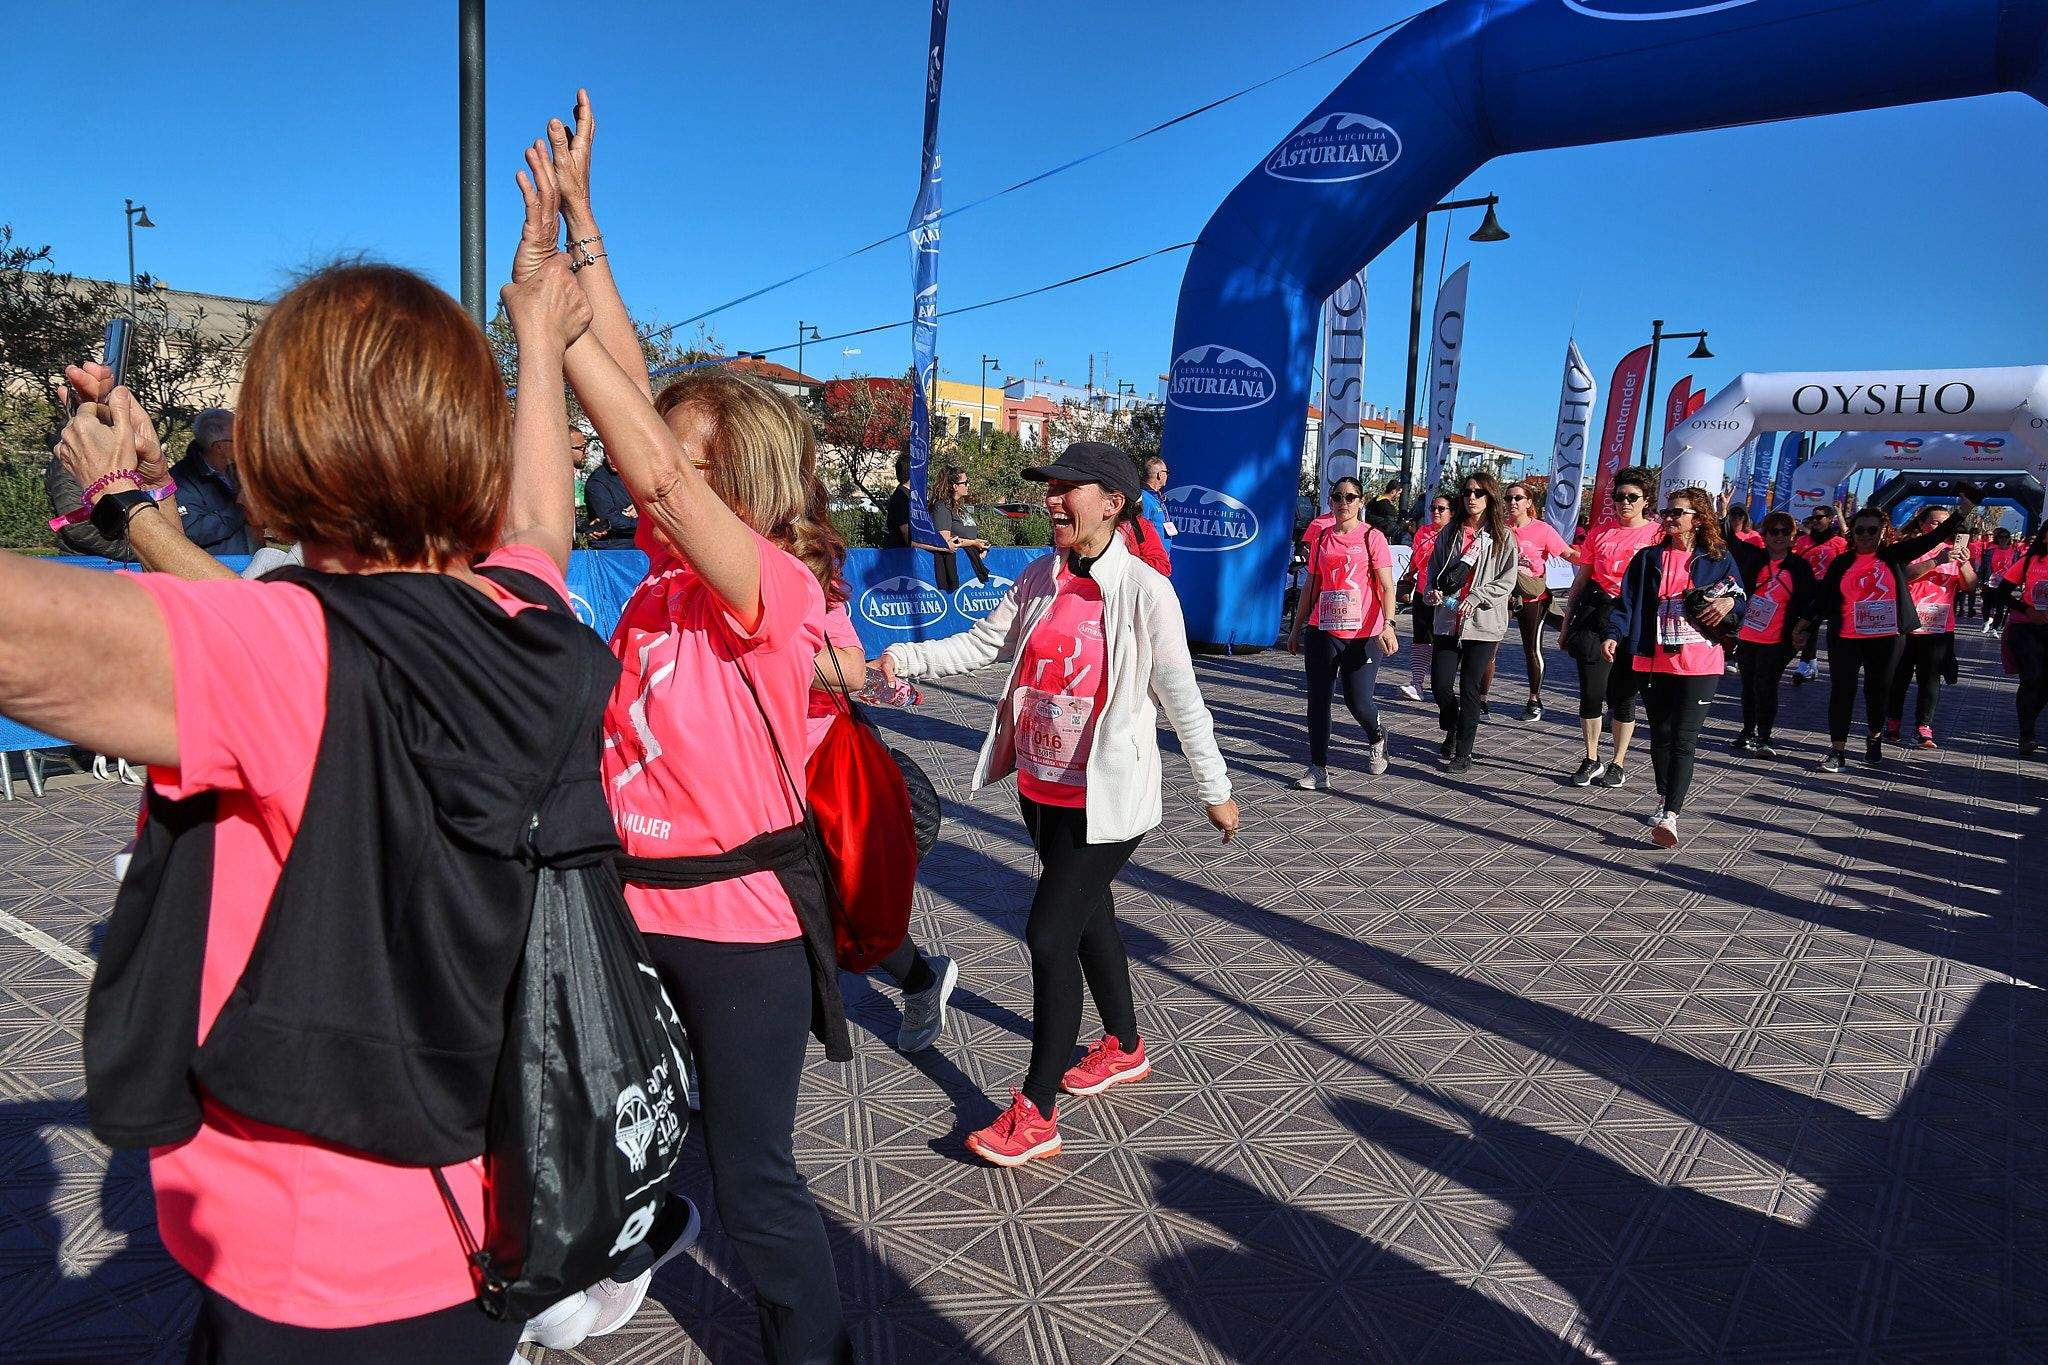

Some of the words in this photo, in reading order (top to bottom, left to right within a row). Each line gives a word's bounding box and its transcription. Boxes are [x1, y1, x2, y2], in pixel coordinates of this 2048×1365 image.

[1294, 135, 1334, 147] CENTRAL
[1338, 132, 1387, 141] LECHERA
[1271, 143, 1390, 170] ASTURIANA
[1180, 367, 1215, 375] CENTRAL
[1219, 368, 1264, 379] LECHERA
[1169, 369, 1266, 398] ASTURIANA
[1792, 382, 1976, 415] OYSHO
[1611, 371, 1638, 453] Santander
[1691, 420, 1740, 430] OYSHO
[1553, 365, 1592, 510] OYSHO
[1664, 478, 1707, 489] OYSHO
[1918, 480, 2006, 489] VOVO
[1169, 505, 1199, 515] ENTRAL
[1202, 508, 1247, 519] LECHERA
[868, 596, 943, 617] ASTURIANA
[962, 592, 1003, 612] ASTUR
[1331, 607, 1348, 615] 016
[1033, 730, 1063, 750] 016
[622, 813, 672, 840] MUJER
